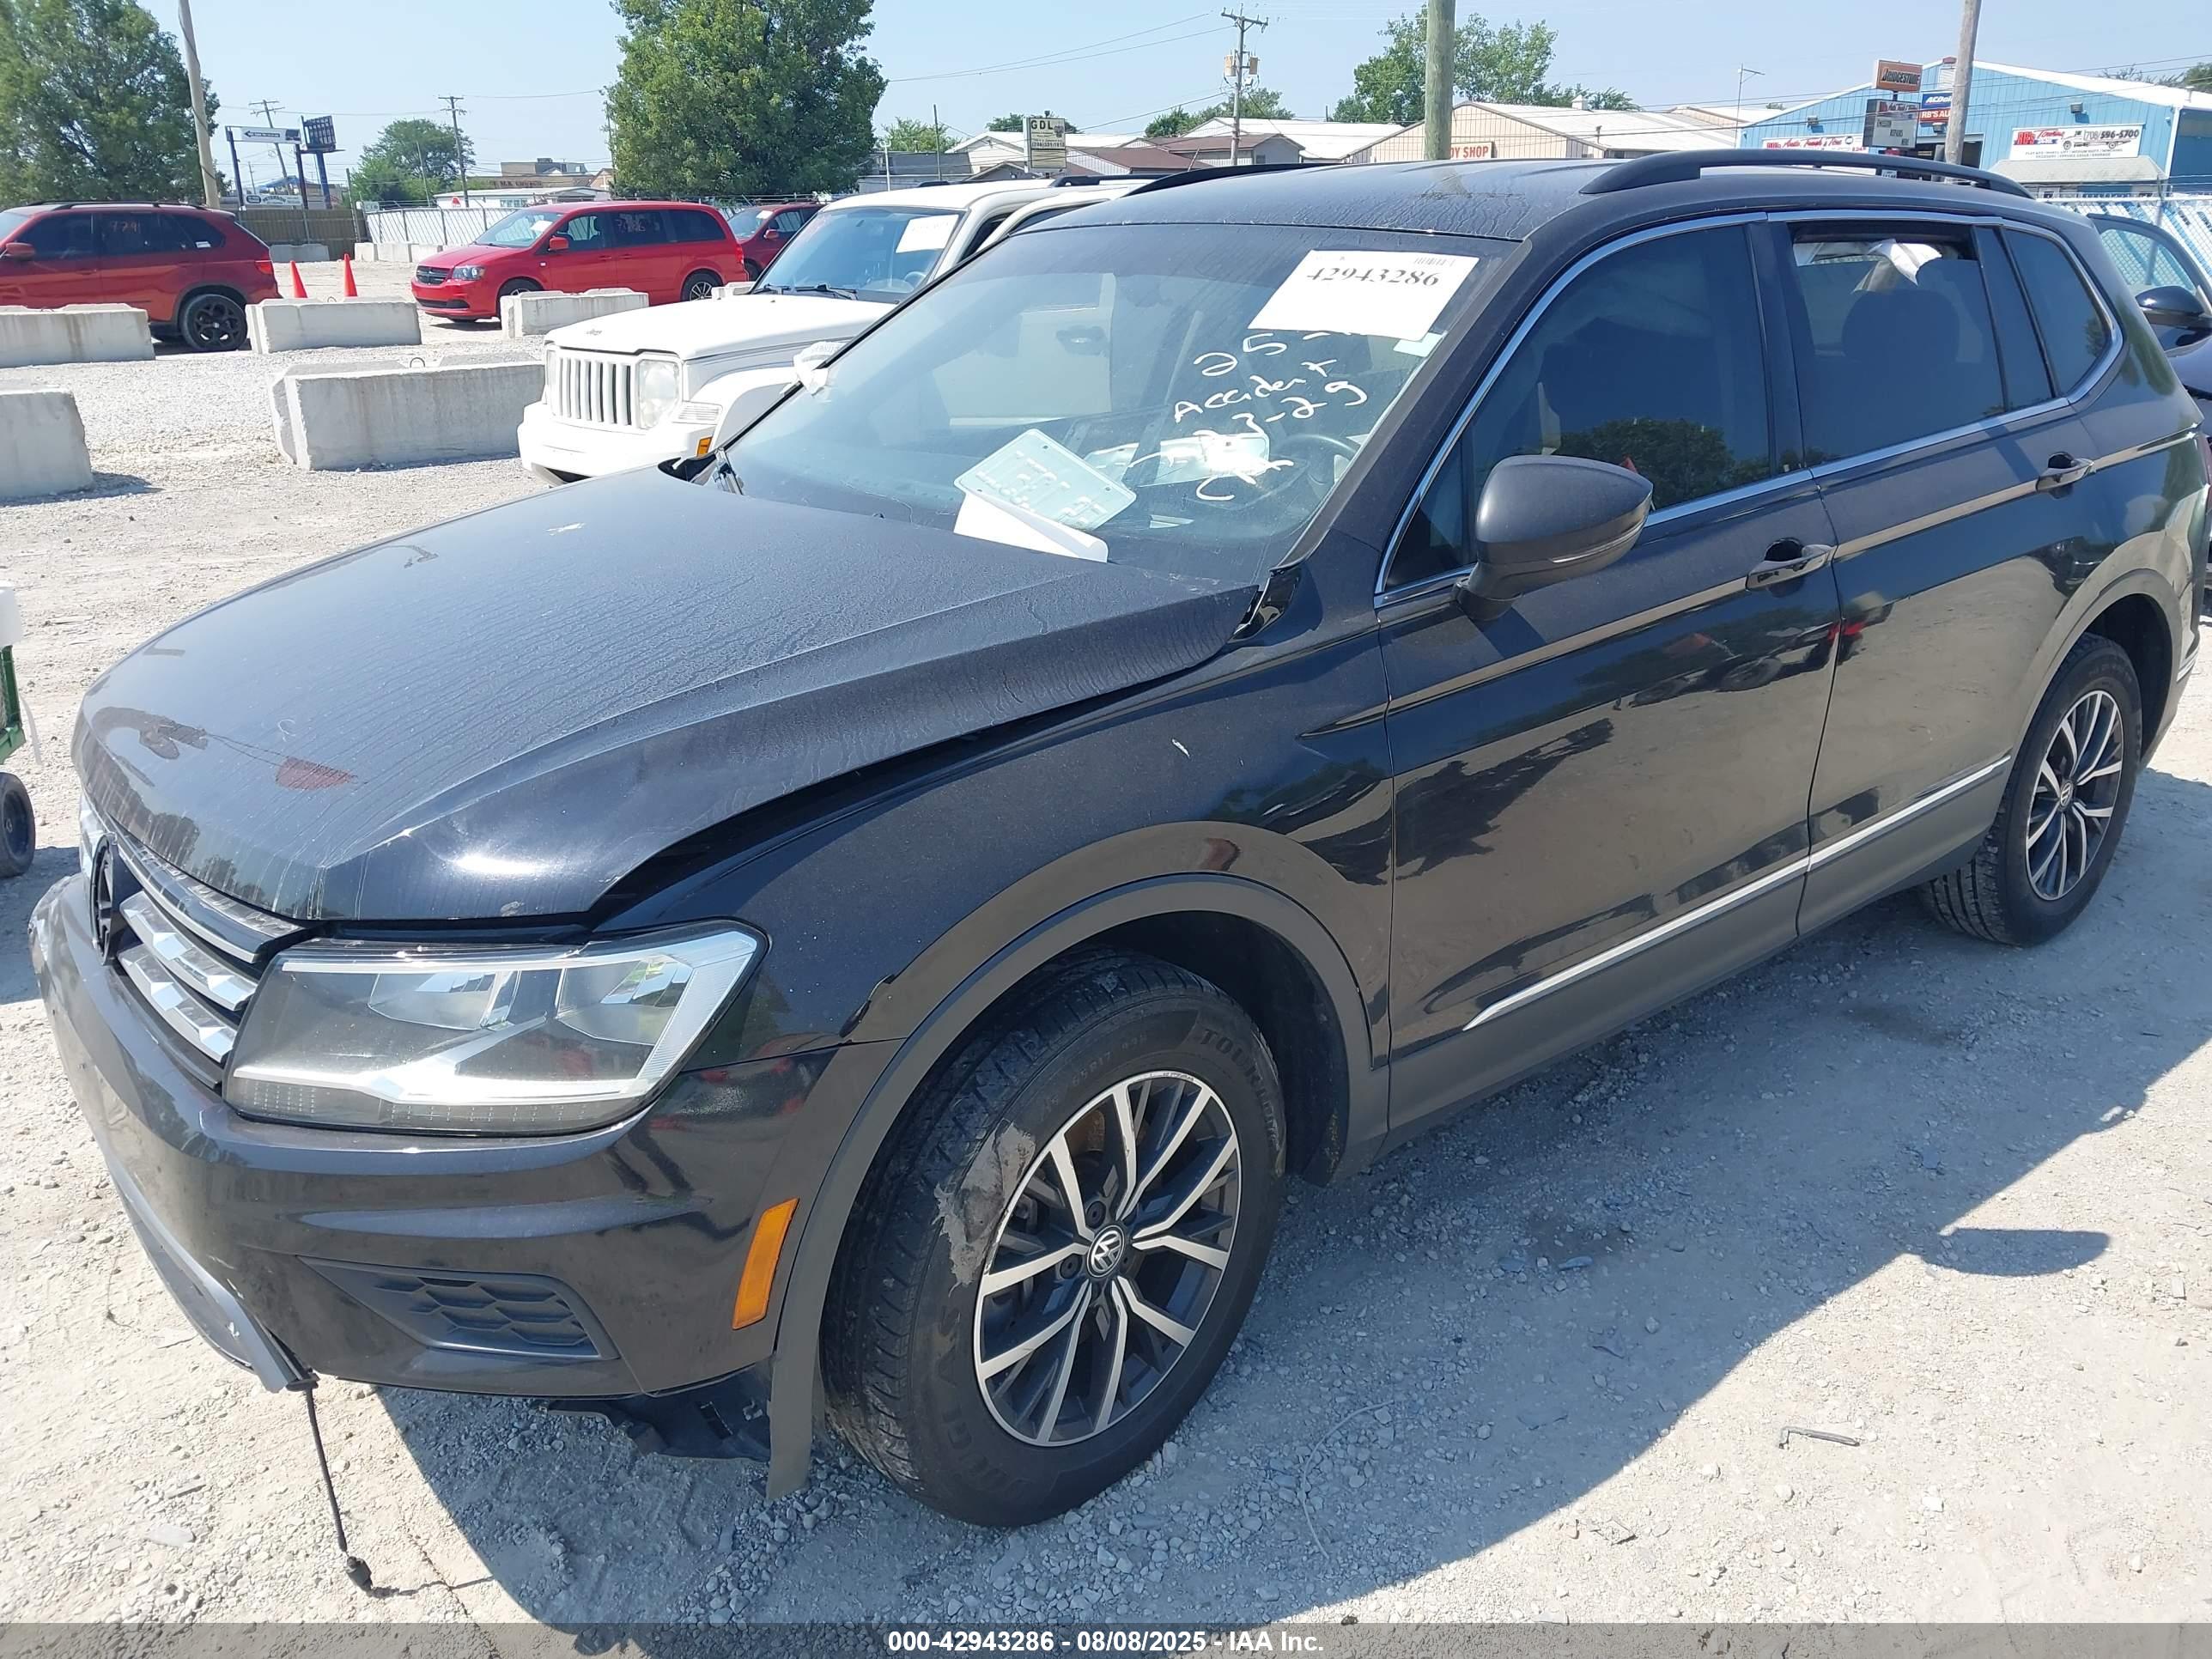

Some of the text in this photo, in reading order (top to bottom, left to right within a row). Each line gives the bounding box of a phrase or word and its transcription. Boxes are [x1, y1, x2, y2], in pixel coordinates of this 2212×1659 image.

[1030, 120, 1054, 130] GDL
[1462, 146, 1489, 158] SHOP
[1307, 267, 1441, 286] 42943286
